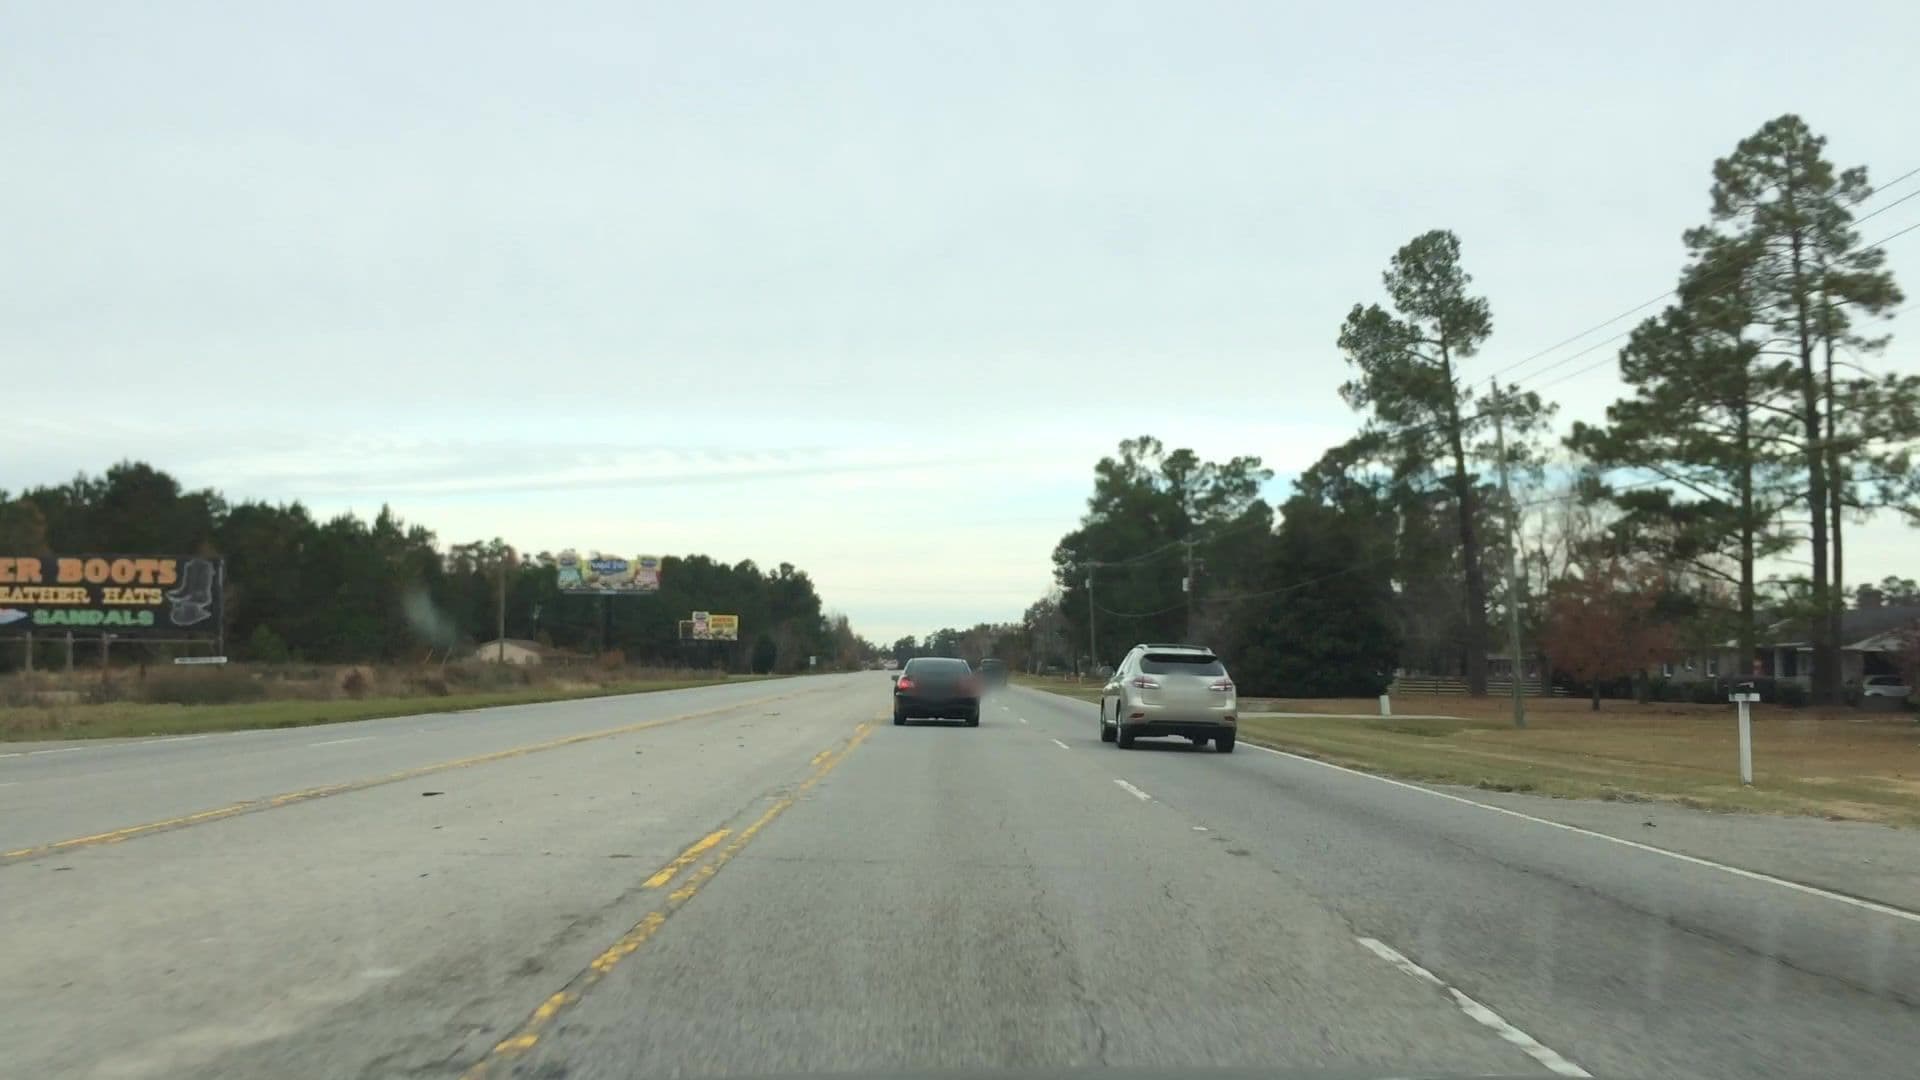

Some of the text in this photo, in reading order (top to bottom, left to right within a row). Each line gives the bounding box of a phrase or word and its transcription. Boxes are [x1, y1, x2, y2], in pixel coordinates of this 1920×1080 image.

[57, 557, 176, 584] BOOTS
[102, 587, 162, 604] HATS
[32, 608, 154, 625] SANDALS
